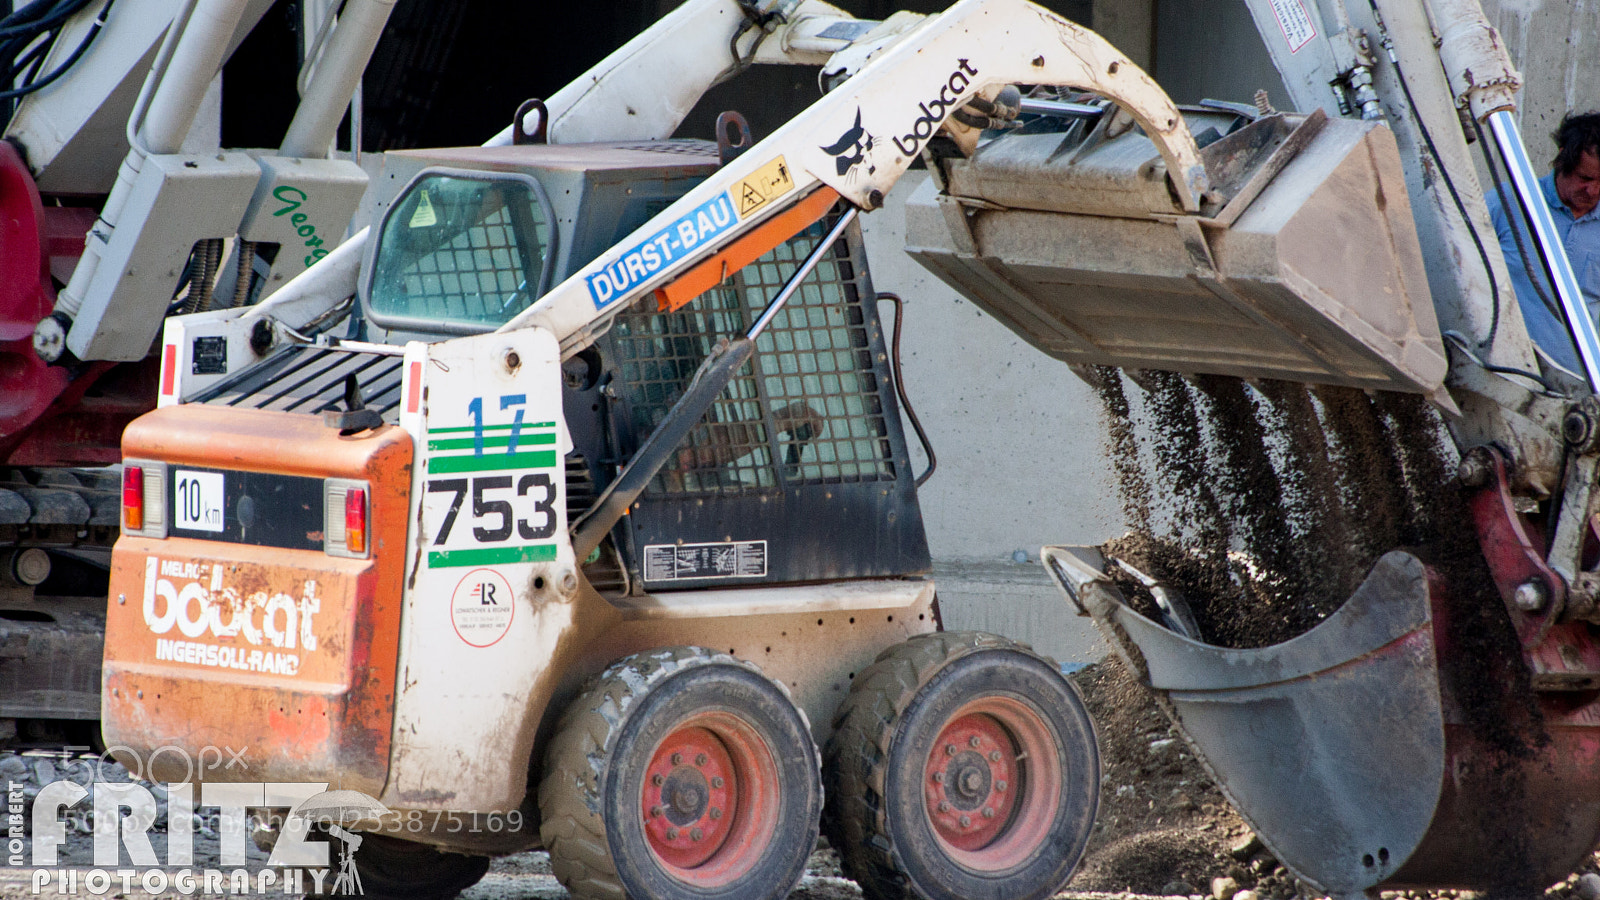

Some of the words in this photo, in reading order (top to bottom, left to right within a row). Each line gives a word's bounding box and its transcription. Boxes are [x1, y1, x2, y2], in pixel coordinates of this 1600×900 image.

[892, 58, 978, 157] bobcat
[592, 197, 731, 304] DURST-BAU
[468, 394, 527, 459] 17
[178, 478, 200, 522] 10
[204, 500, 221, 524] km
[427, 473, 557, 546] 753
[142, 556, 321, 651] bobcat
[155, 638, 299, 676] INGERSOLL-RAND
